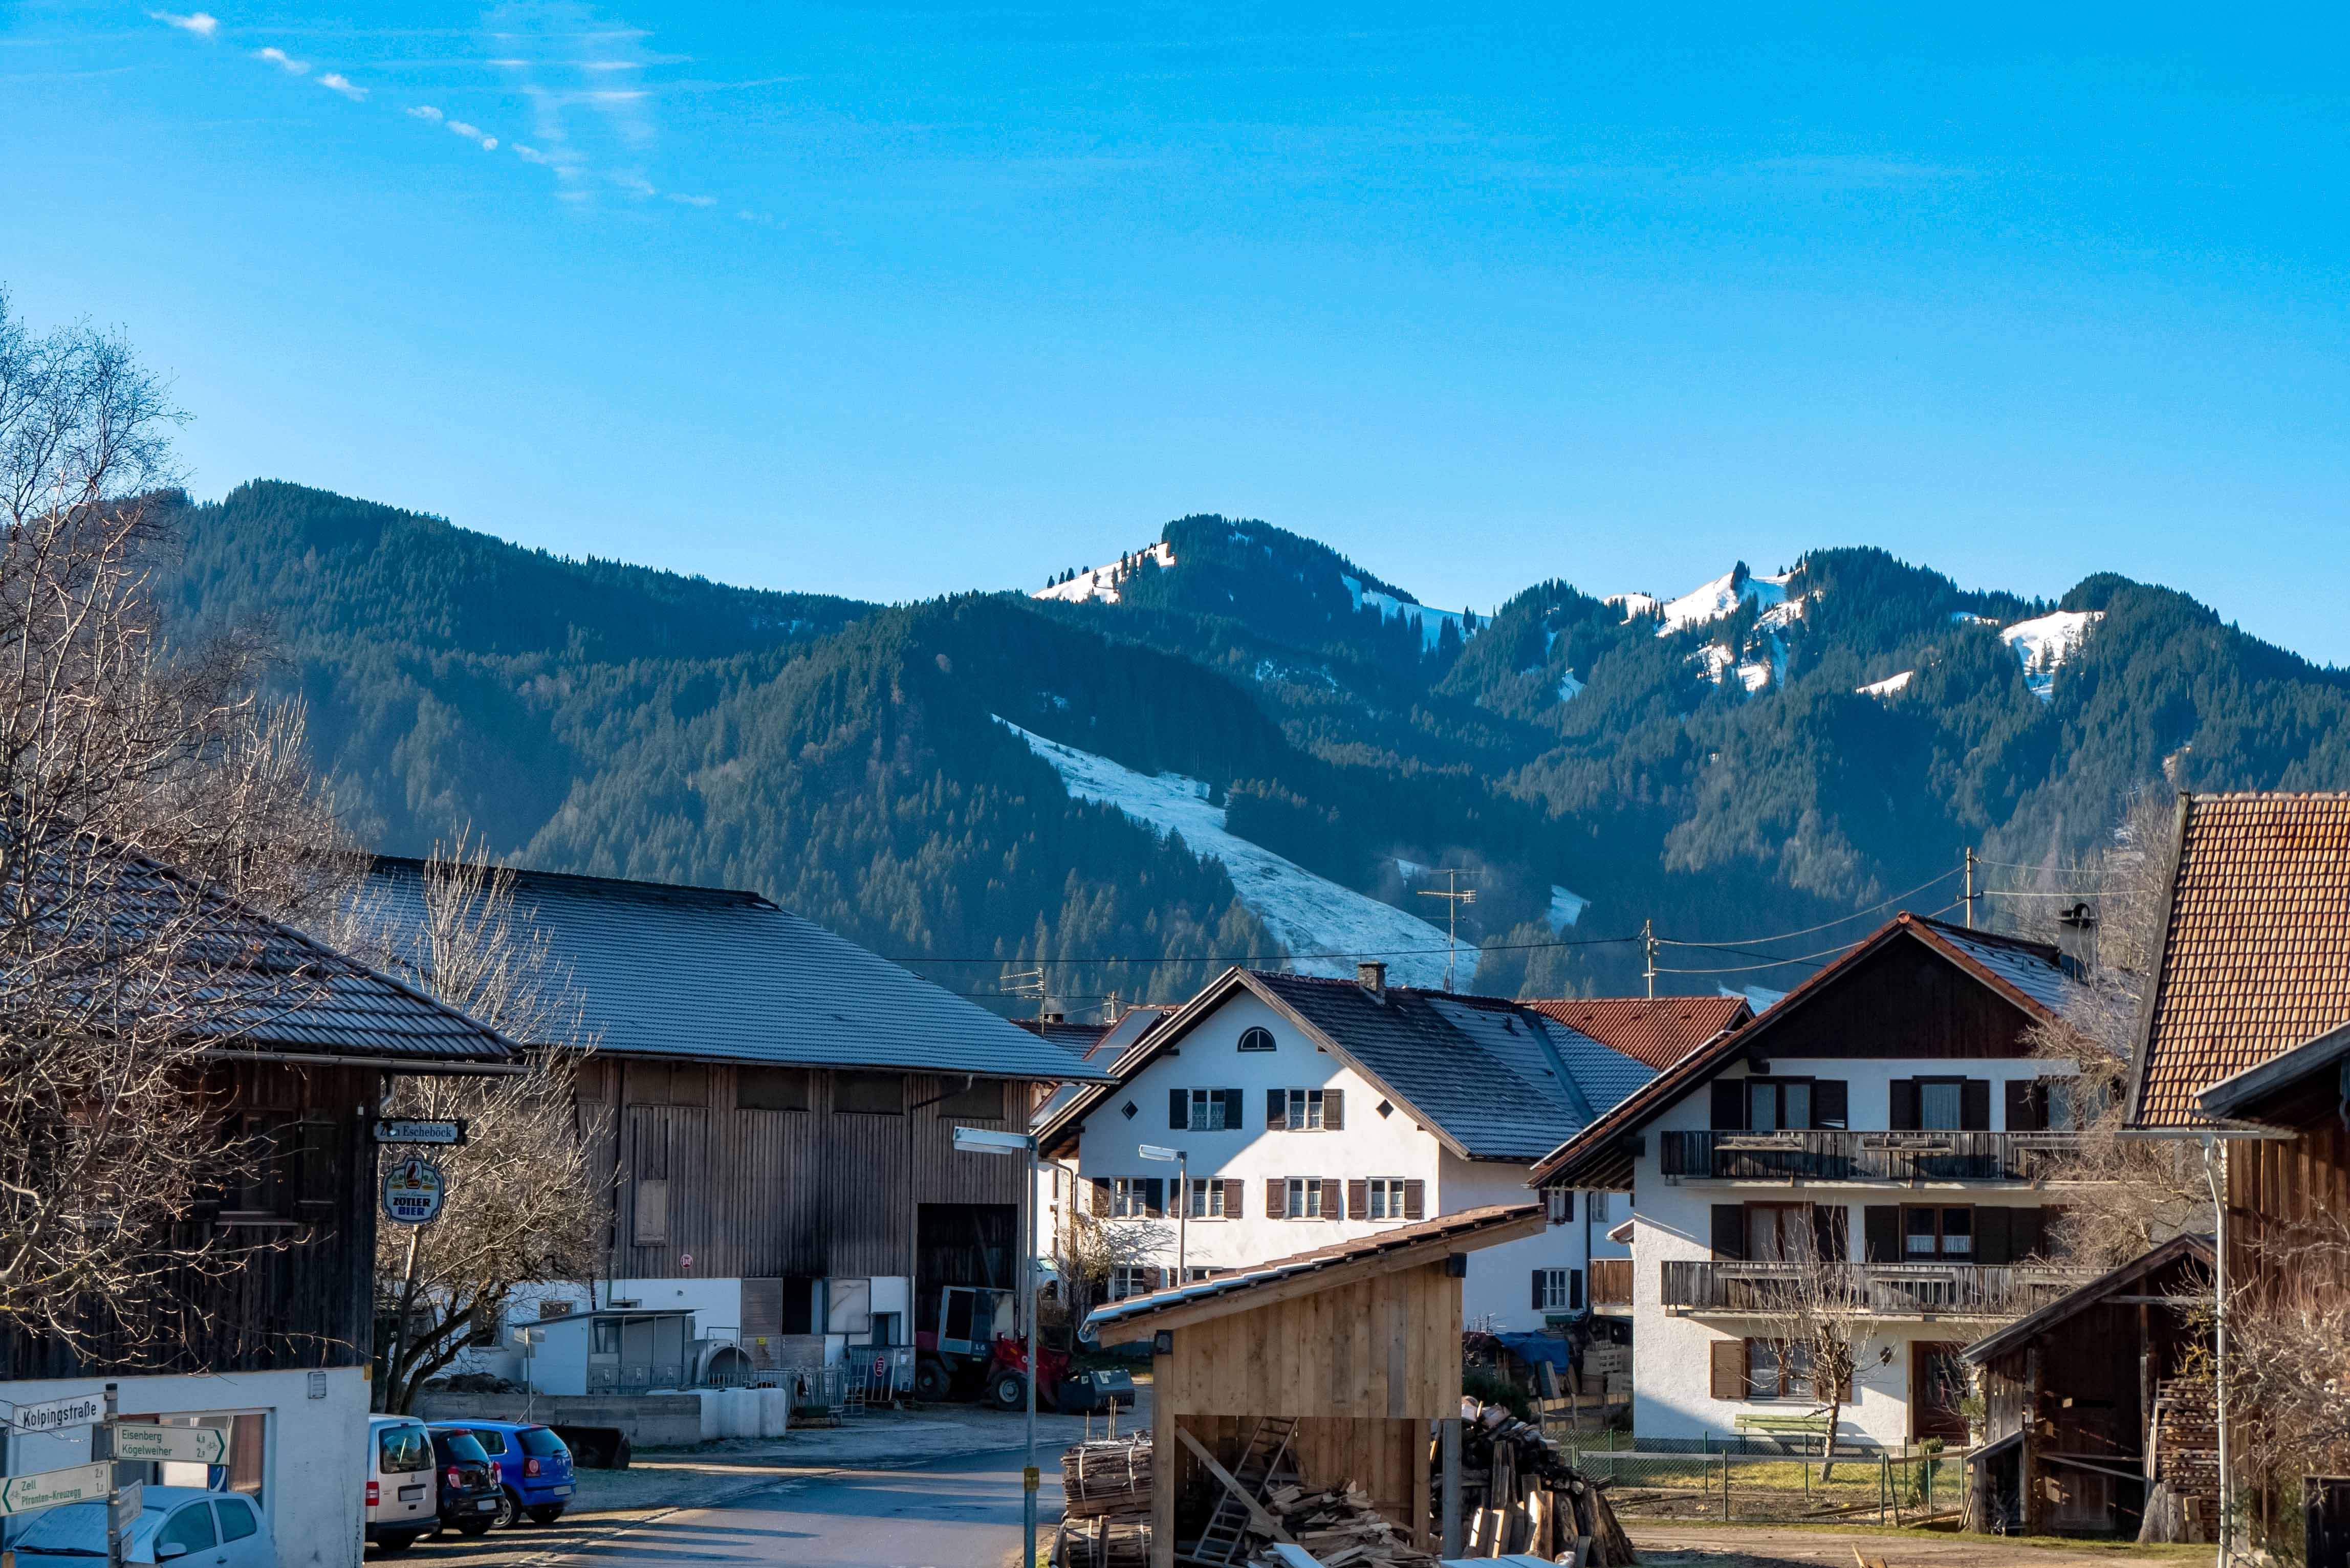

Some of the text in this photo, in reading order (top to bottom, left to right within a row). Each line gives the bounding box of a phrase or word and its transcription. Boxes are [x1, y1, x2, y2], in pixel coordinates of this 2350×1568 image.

[403, 1126, 452, 1137] Escheböck
[398, 1207, 425, 1216] BIER
[24, 1401, 97, 1429] Kolpingstraße
[122, 1429, 162, 1443] Eisenberg
[122, 1444, 172, 1456] Kögelweiher
[21, 1479, 37, 1491] Zell
[21, 1488, 81, 1506] Pfronten-Kreuzegg
